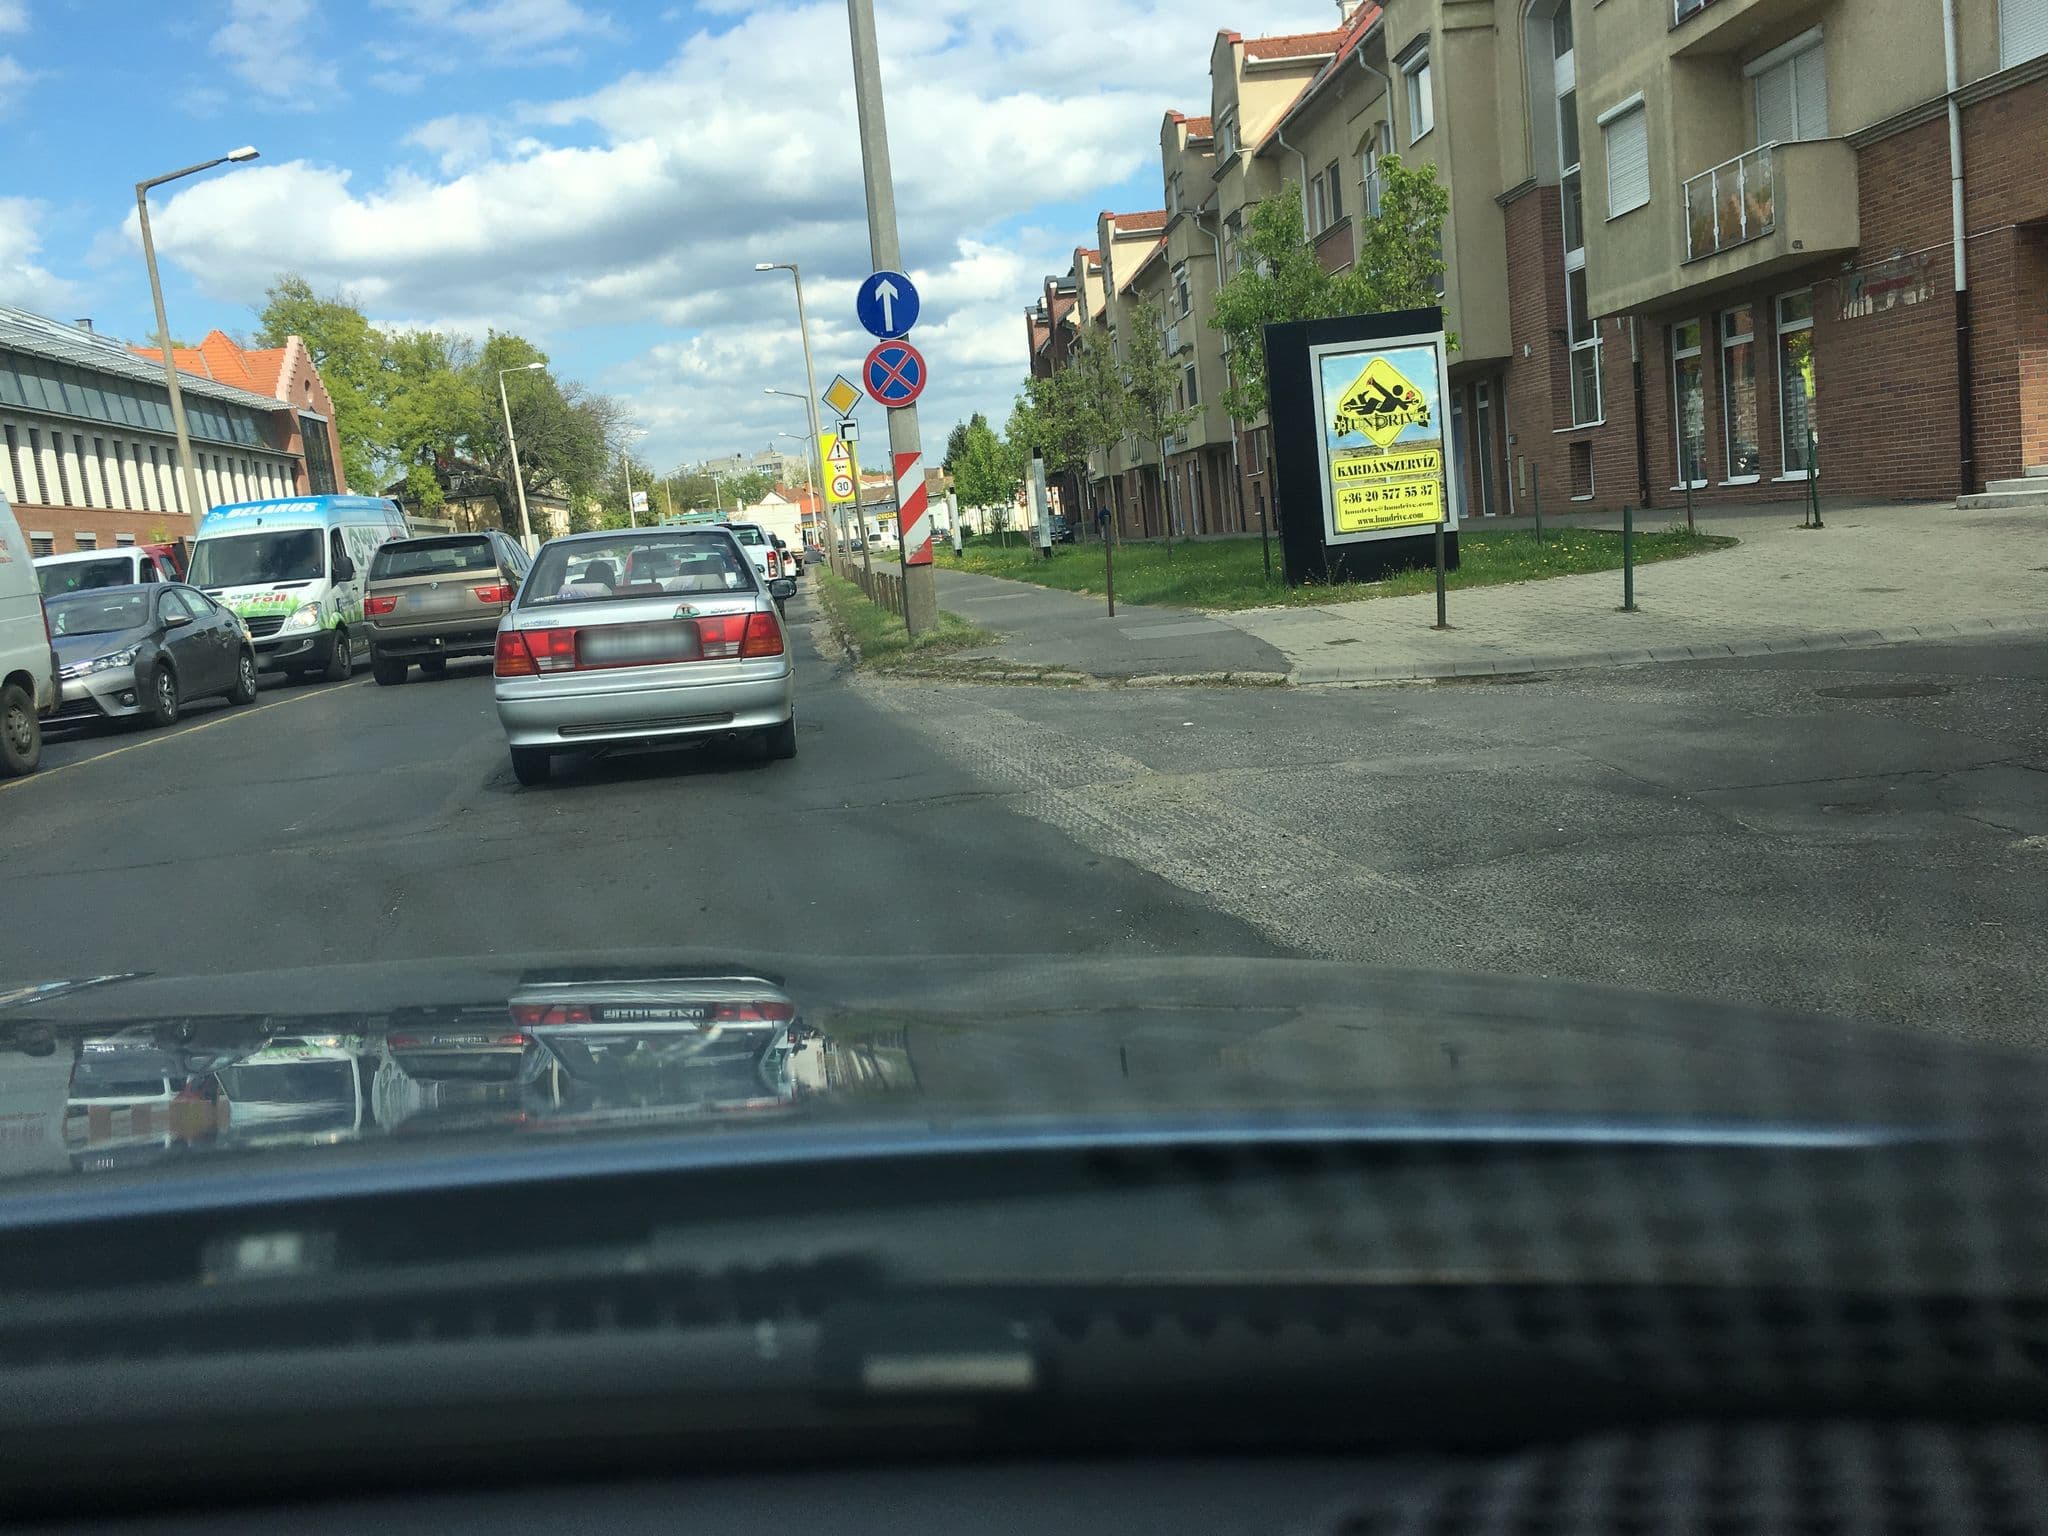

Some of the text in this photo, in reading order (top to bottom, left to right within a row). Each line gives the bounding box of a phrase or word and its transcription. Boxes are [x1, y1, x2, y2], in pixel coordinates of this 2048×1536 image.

[1337, 455, 1435, 477] KARDÁNSZERVÍZ
[836, 482, 849, 491] 30
[1343, 484, 1433, 505] +36 20 577 55 37
[227, 503, 318, 518] BELARUS
[1357, 512, 1423, 525] www.hundrive.com
[252, 594, 287, 604] roll
